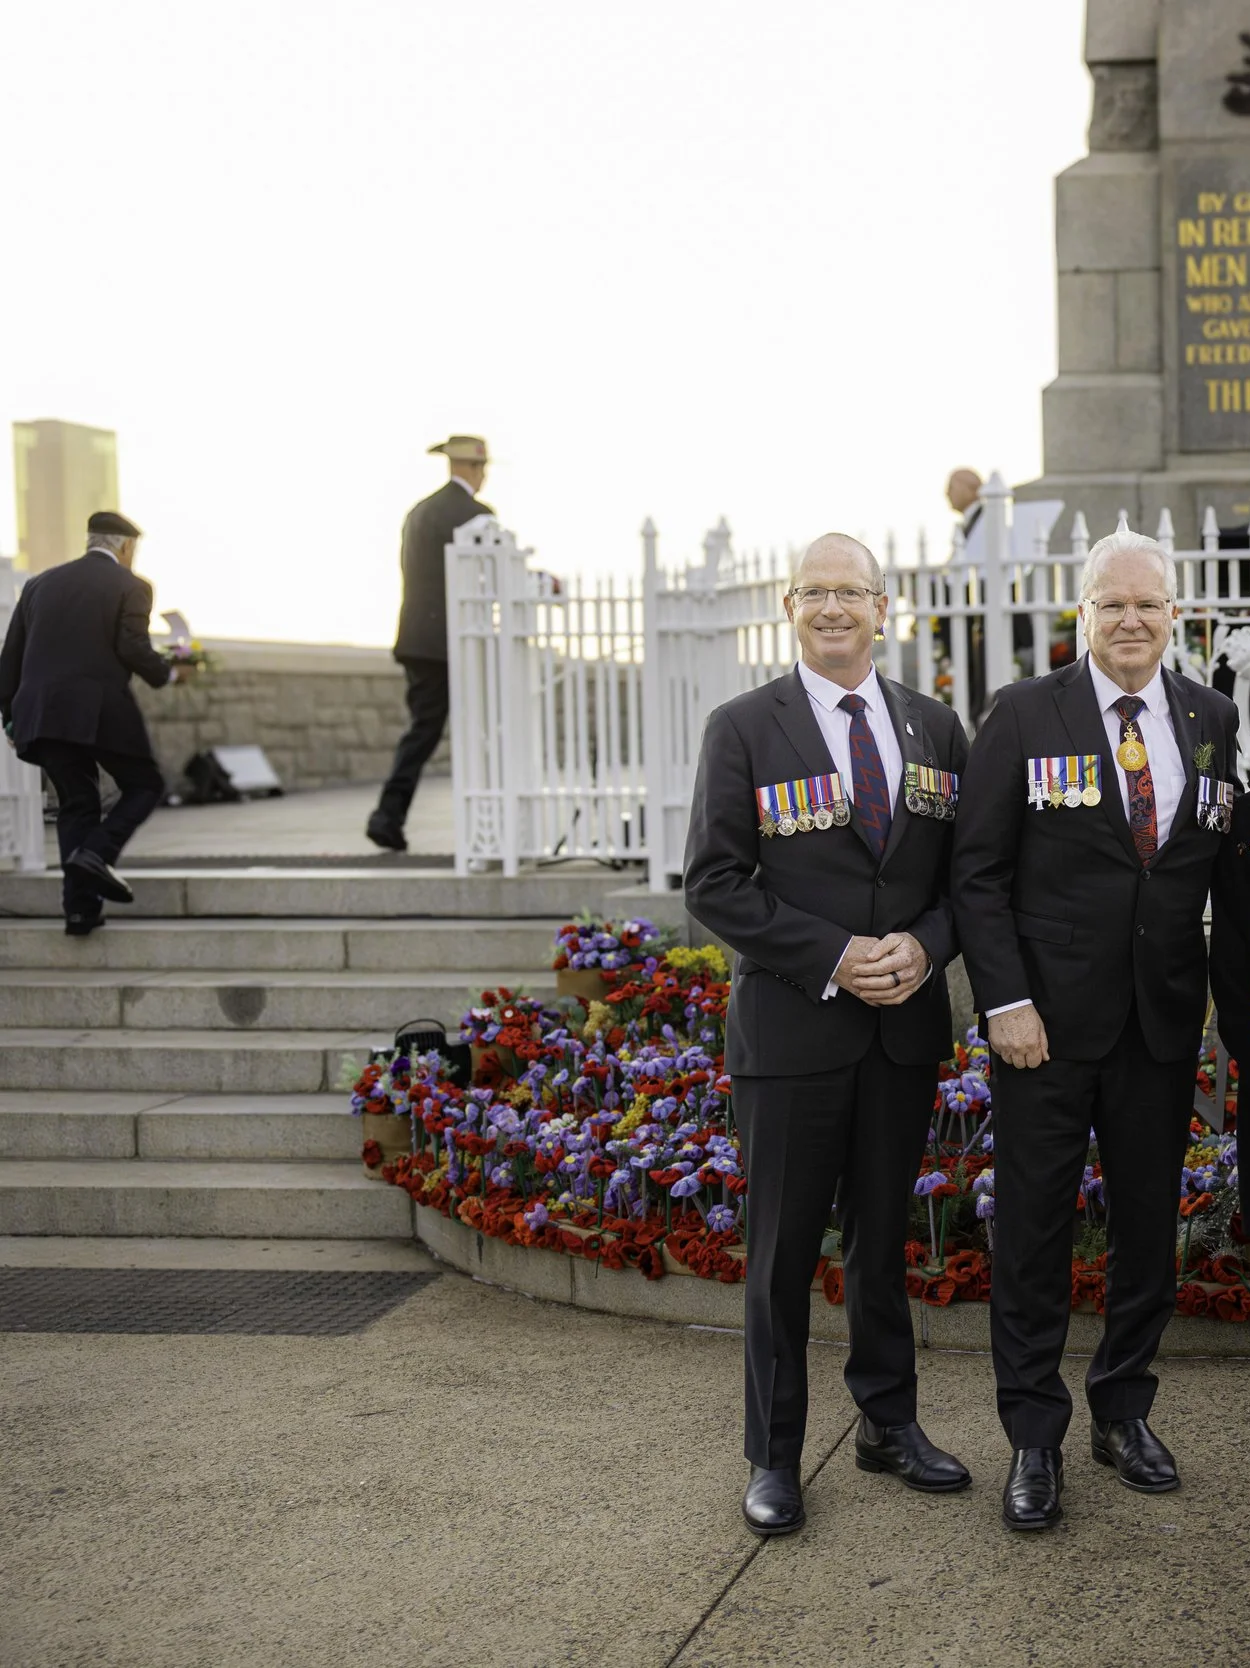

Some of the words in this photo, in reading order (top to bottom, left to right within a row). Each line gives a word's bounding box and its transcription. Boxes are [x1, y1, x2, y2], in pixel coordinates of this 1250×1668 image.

[1198, 192, 1225, 213] BY
[1178, 218, 1206, 248] IN
[1186, 254, 1247, 286] MEN
[1186, 294, 1233, 312] WHO
